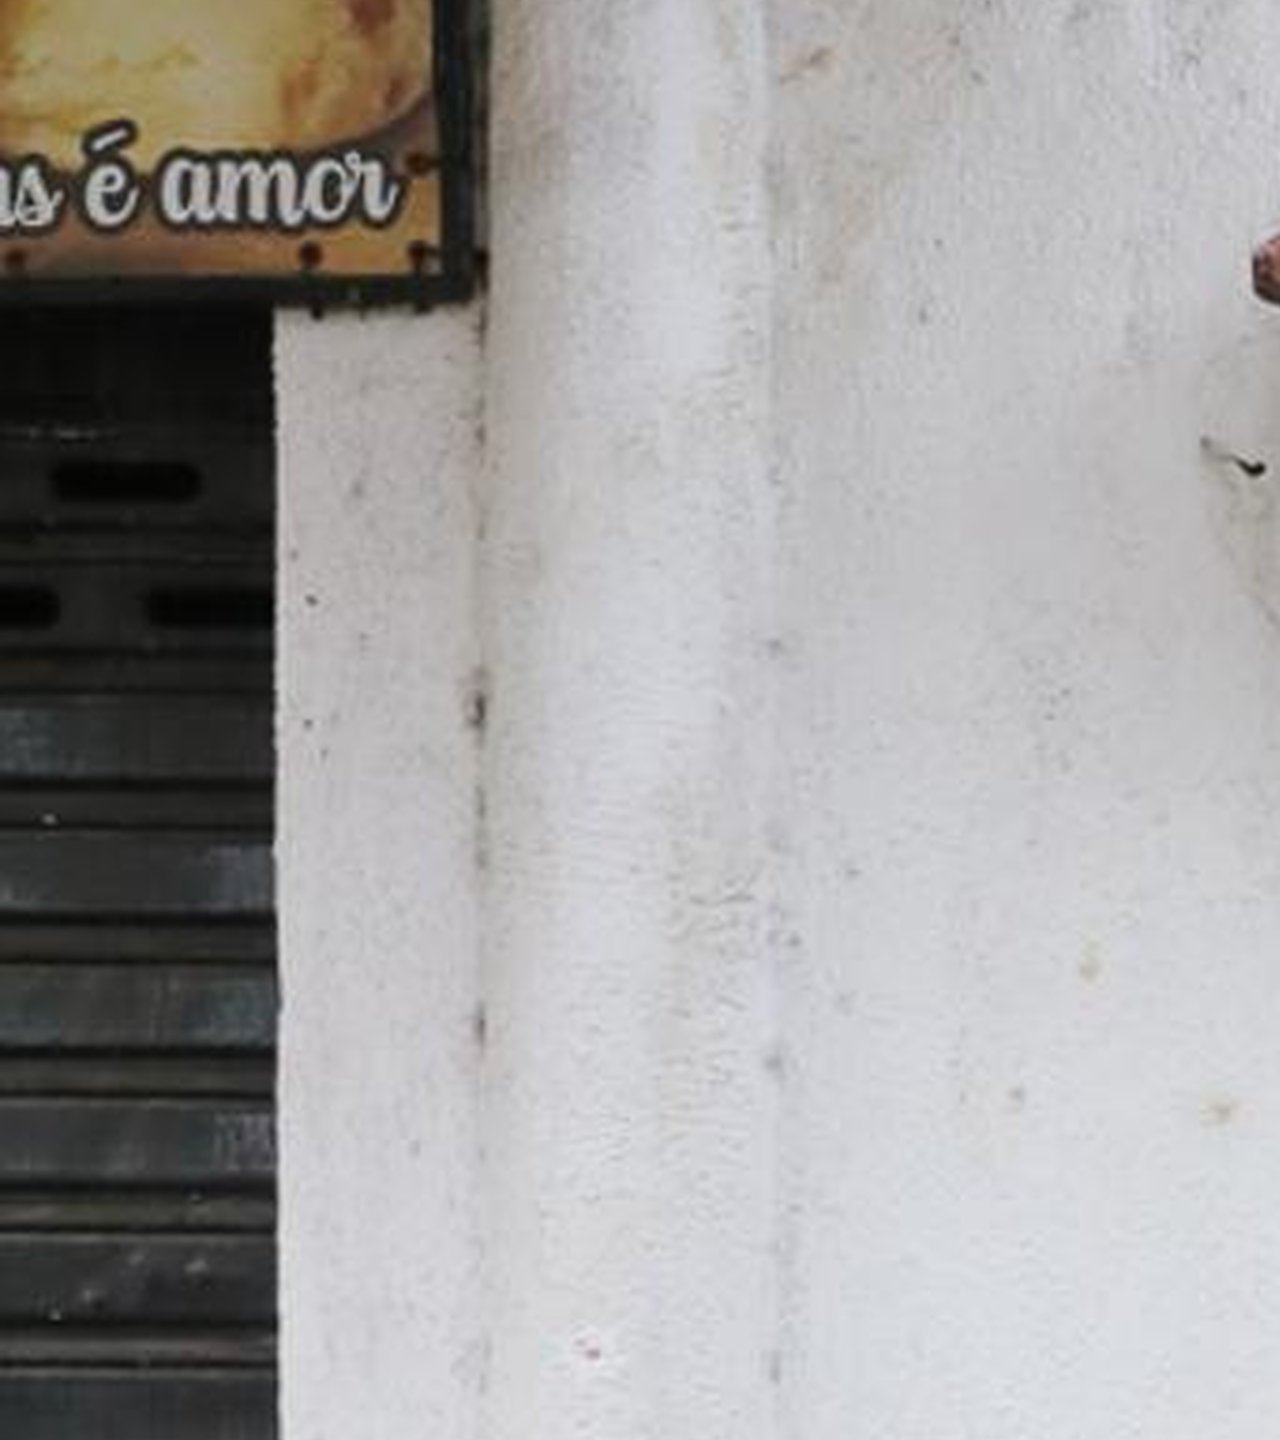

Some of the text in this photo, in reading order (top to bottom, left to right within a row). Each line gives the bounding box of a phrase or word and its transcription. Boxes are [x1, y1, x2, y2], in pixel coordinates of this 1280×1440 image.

[0, 127, 398, 228] s é amor
